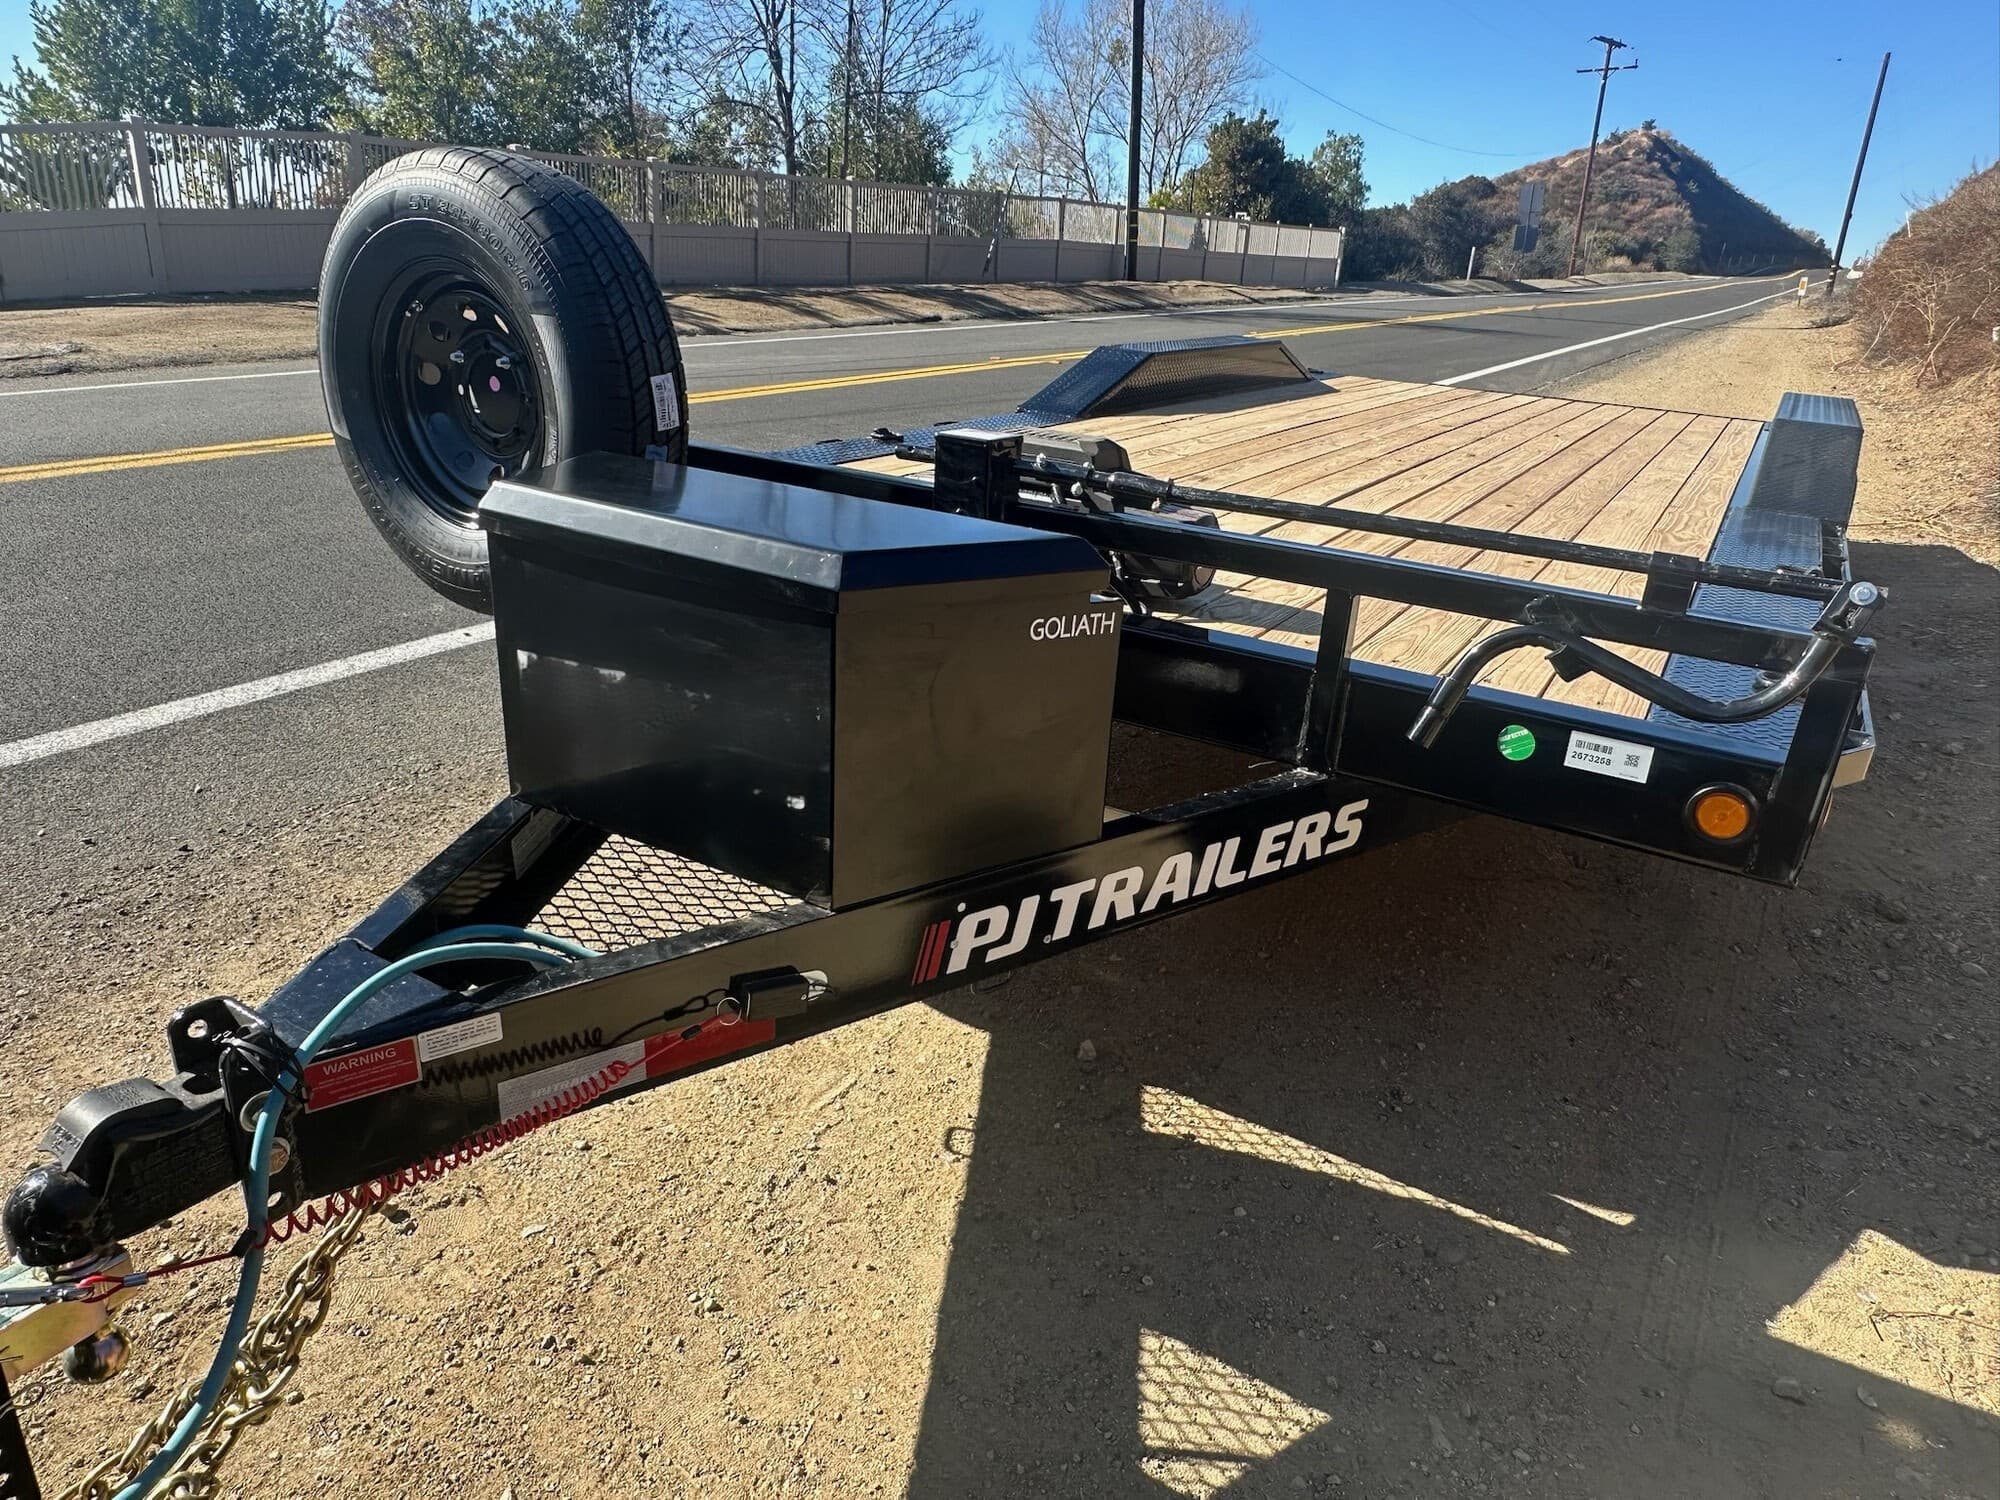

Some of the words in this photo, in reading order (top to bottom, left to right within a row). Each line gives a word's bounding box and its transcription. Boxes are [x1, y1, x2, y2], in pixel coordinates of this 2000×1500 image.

[408, 193, 433, 210] ST
[1030, 612, 1116, 641] GOLIATH
[1571, 750, 1612, 767] 2673258
[946, 894, 1041, 974] PJ
[1050, 799, 1369, 941] TRAILERS
[322, 1047, 397, 1076] WARNING
